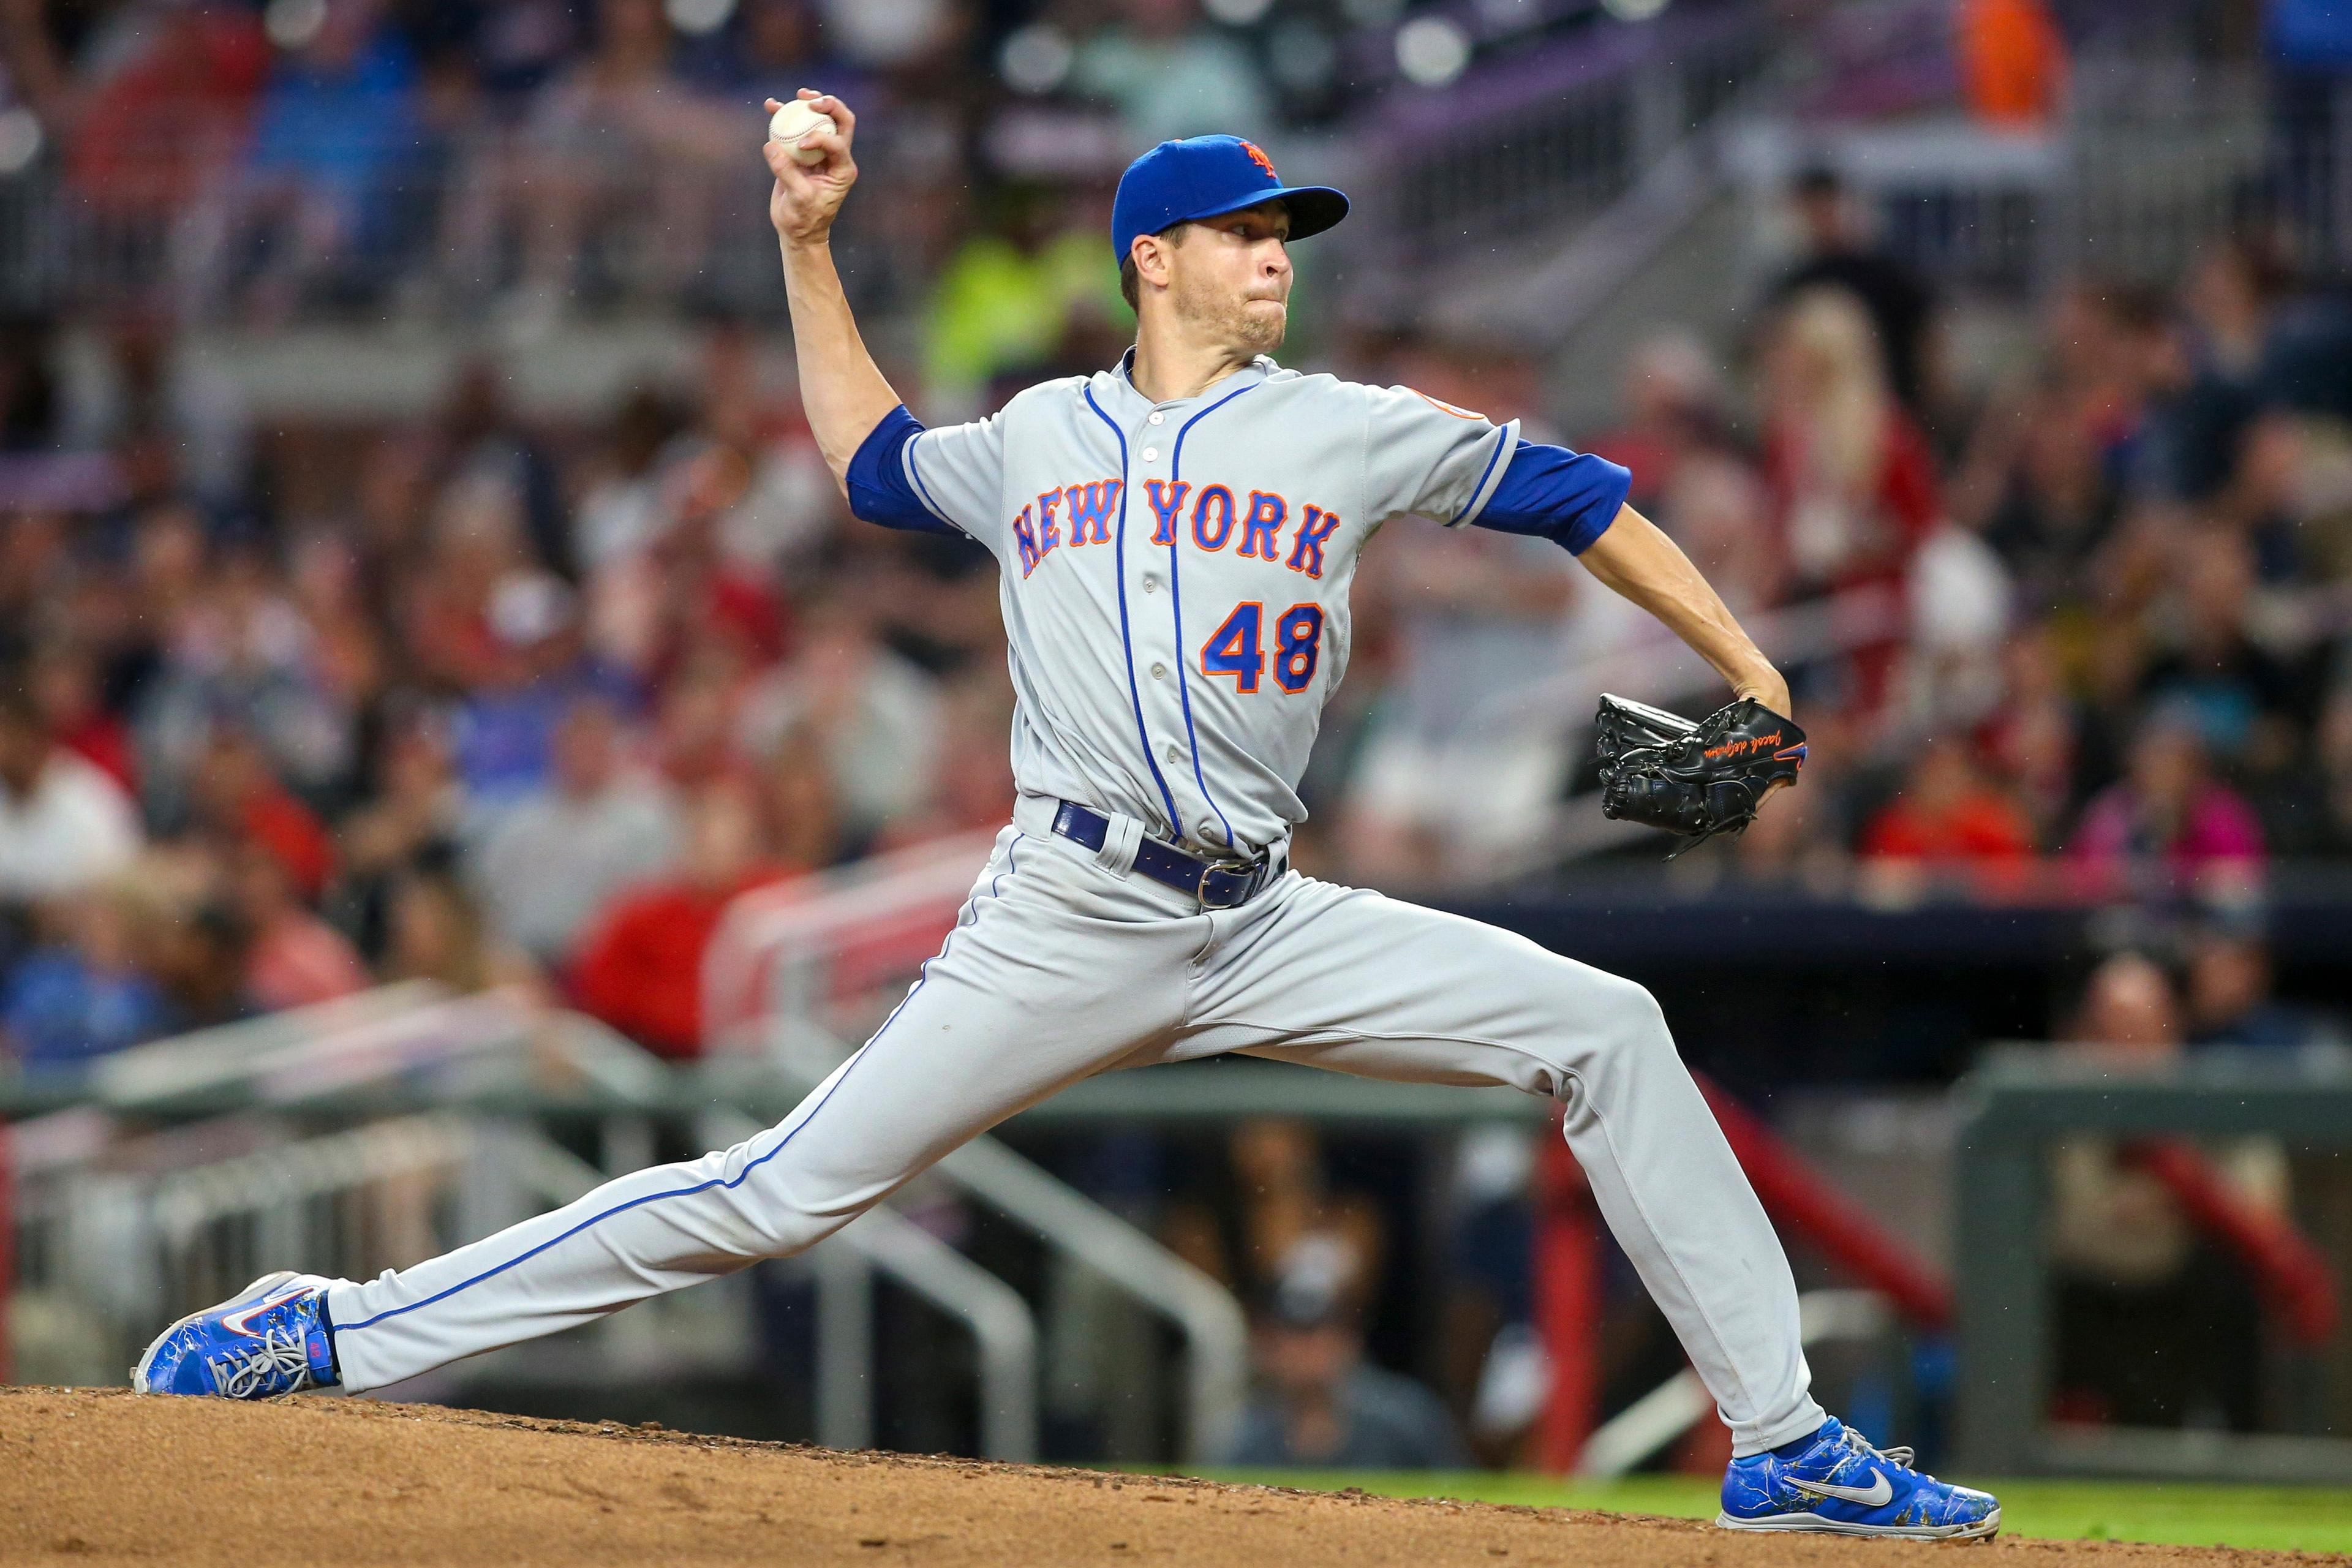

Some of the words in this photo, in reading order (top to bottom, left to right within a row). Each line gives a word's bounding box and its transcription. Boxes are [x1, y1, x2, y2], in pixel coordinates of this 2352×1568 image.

[1013, 478, 1124, 579] NEW
[1144, 478, 1340, 579] YORK
[1200, 601, 1325, 694] 48
[1750, 729, 1782, 754] Jacob
[310, 1342, 321, 1358] 48
